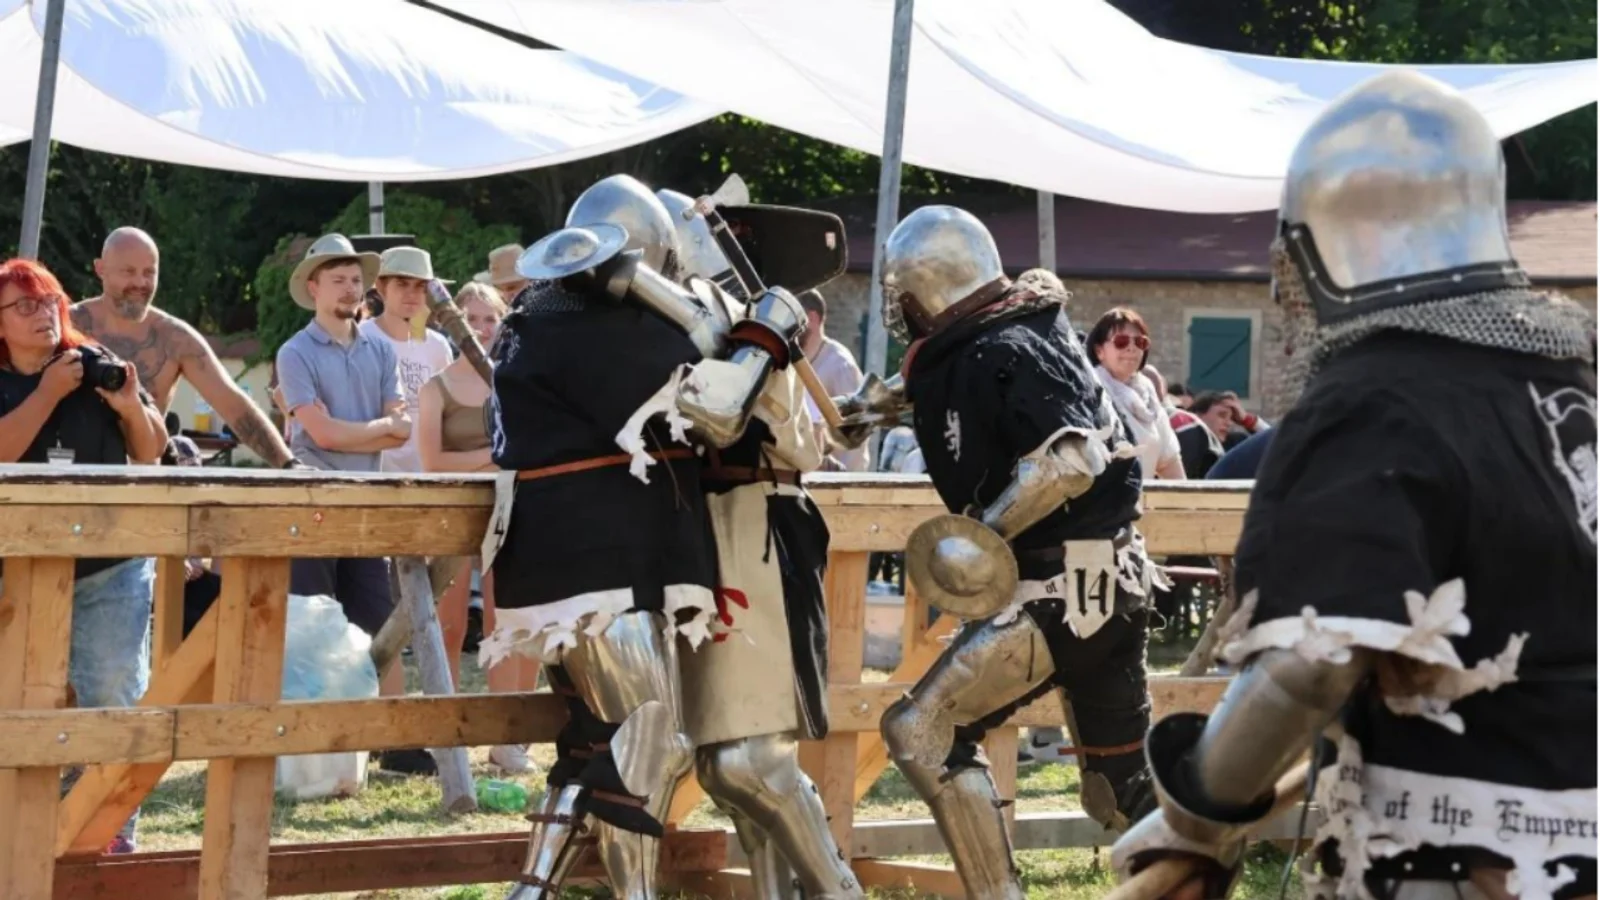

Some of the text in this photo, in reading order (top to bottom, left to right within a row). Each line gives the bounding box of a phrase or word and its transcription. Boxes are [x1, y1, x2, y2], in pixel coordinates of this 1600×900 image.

[1045, 581, 1058, 594] of
[1074, 567, 1109, 617] 14
[1384, 790, 1411, 820] of
[1430, 793, 1473, 836] the
